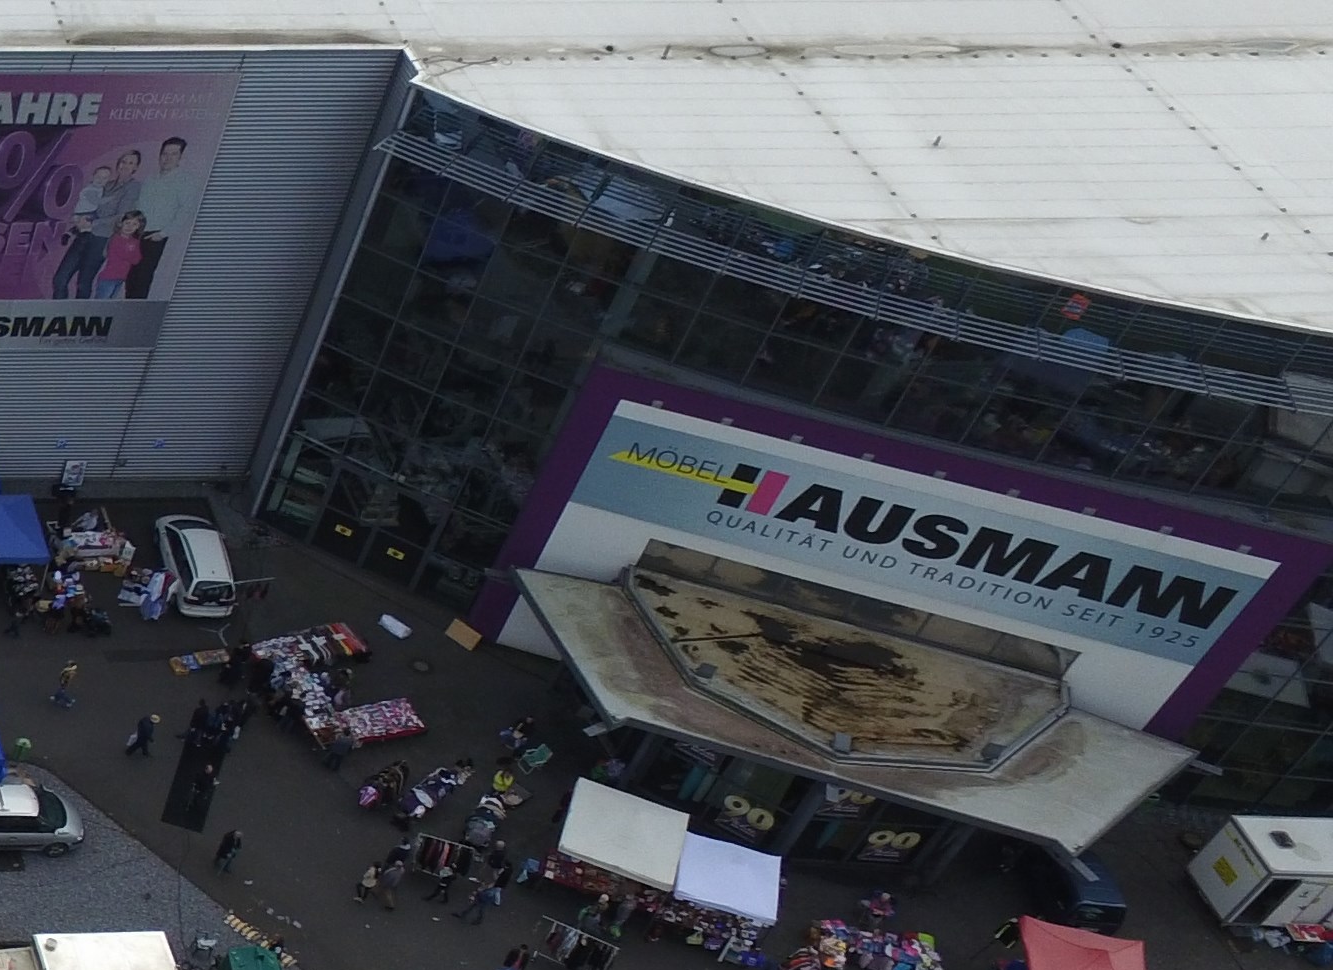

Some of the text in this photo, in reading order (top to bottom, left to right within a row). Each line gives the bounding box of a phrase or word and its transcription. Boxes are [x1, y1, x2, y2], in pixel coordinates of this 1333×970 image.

[125, 92, 184, 105] BEQUEM
[109, 108, 168, 120] KLEINEN
[626, 441, 1239, 629] MÖBEL HAUSMANN
[706, 509, 1202, 651] QUALITÄT UND TRADITION SEIT 1925
[724, 794, 775, 831] 90
[867, 829, 922, 850] 90
